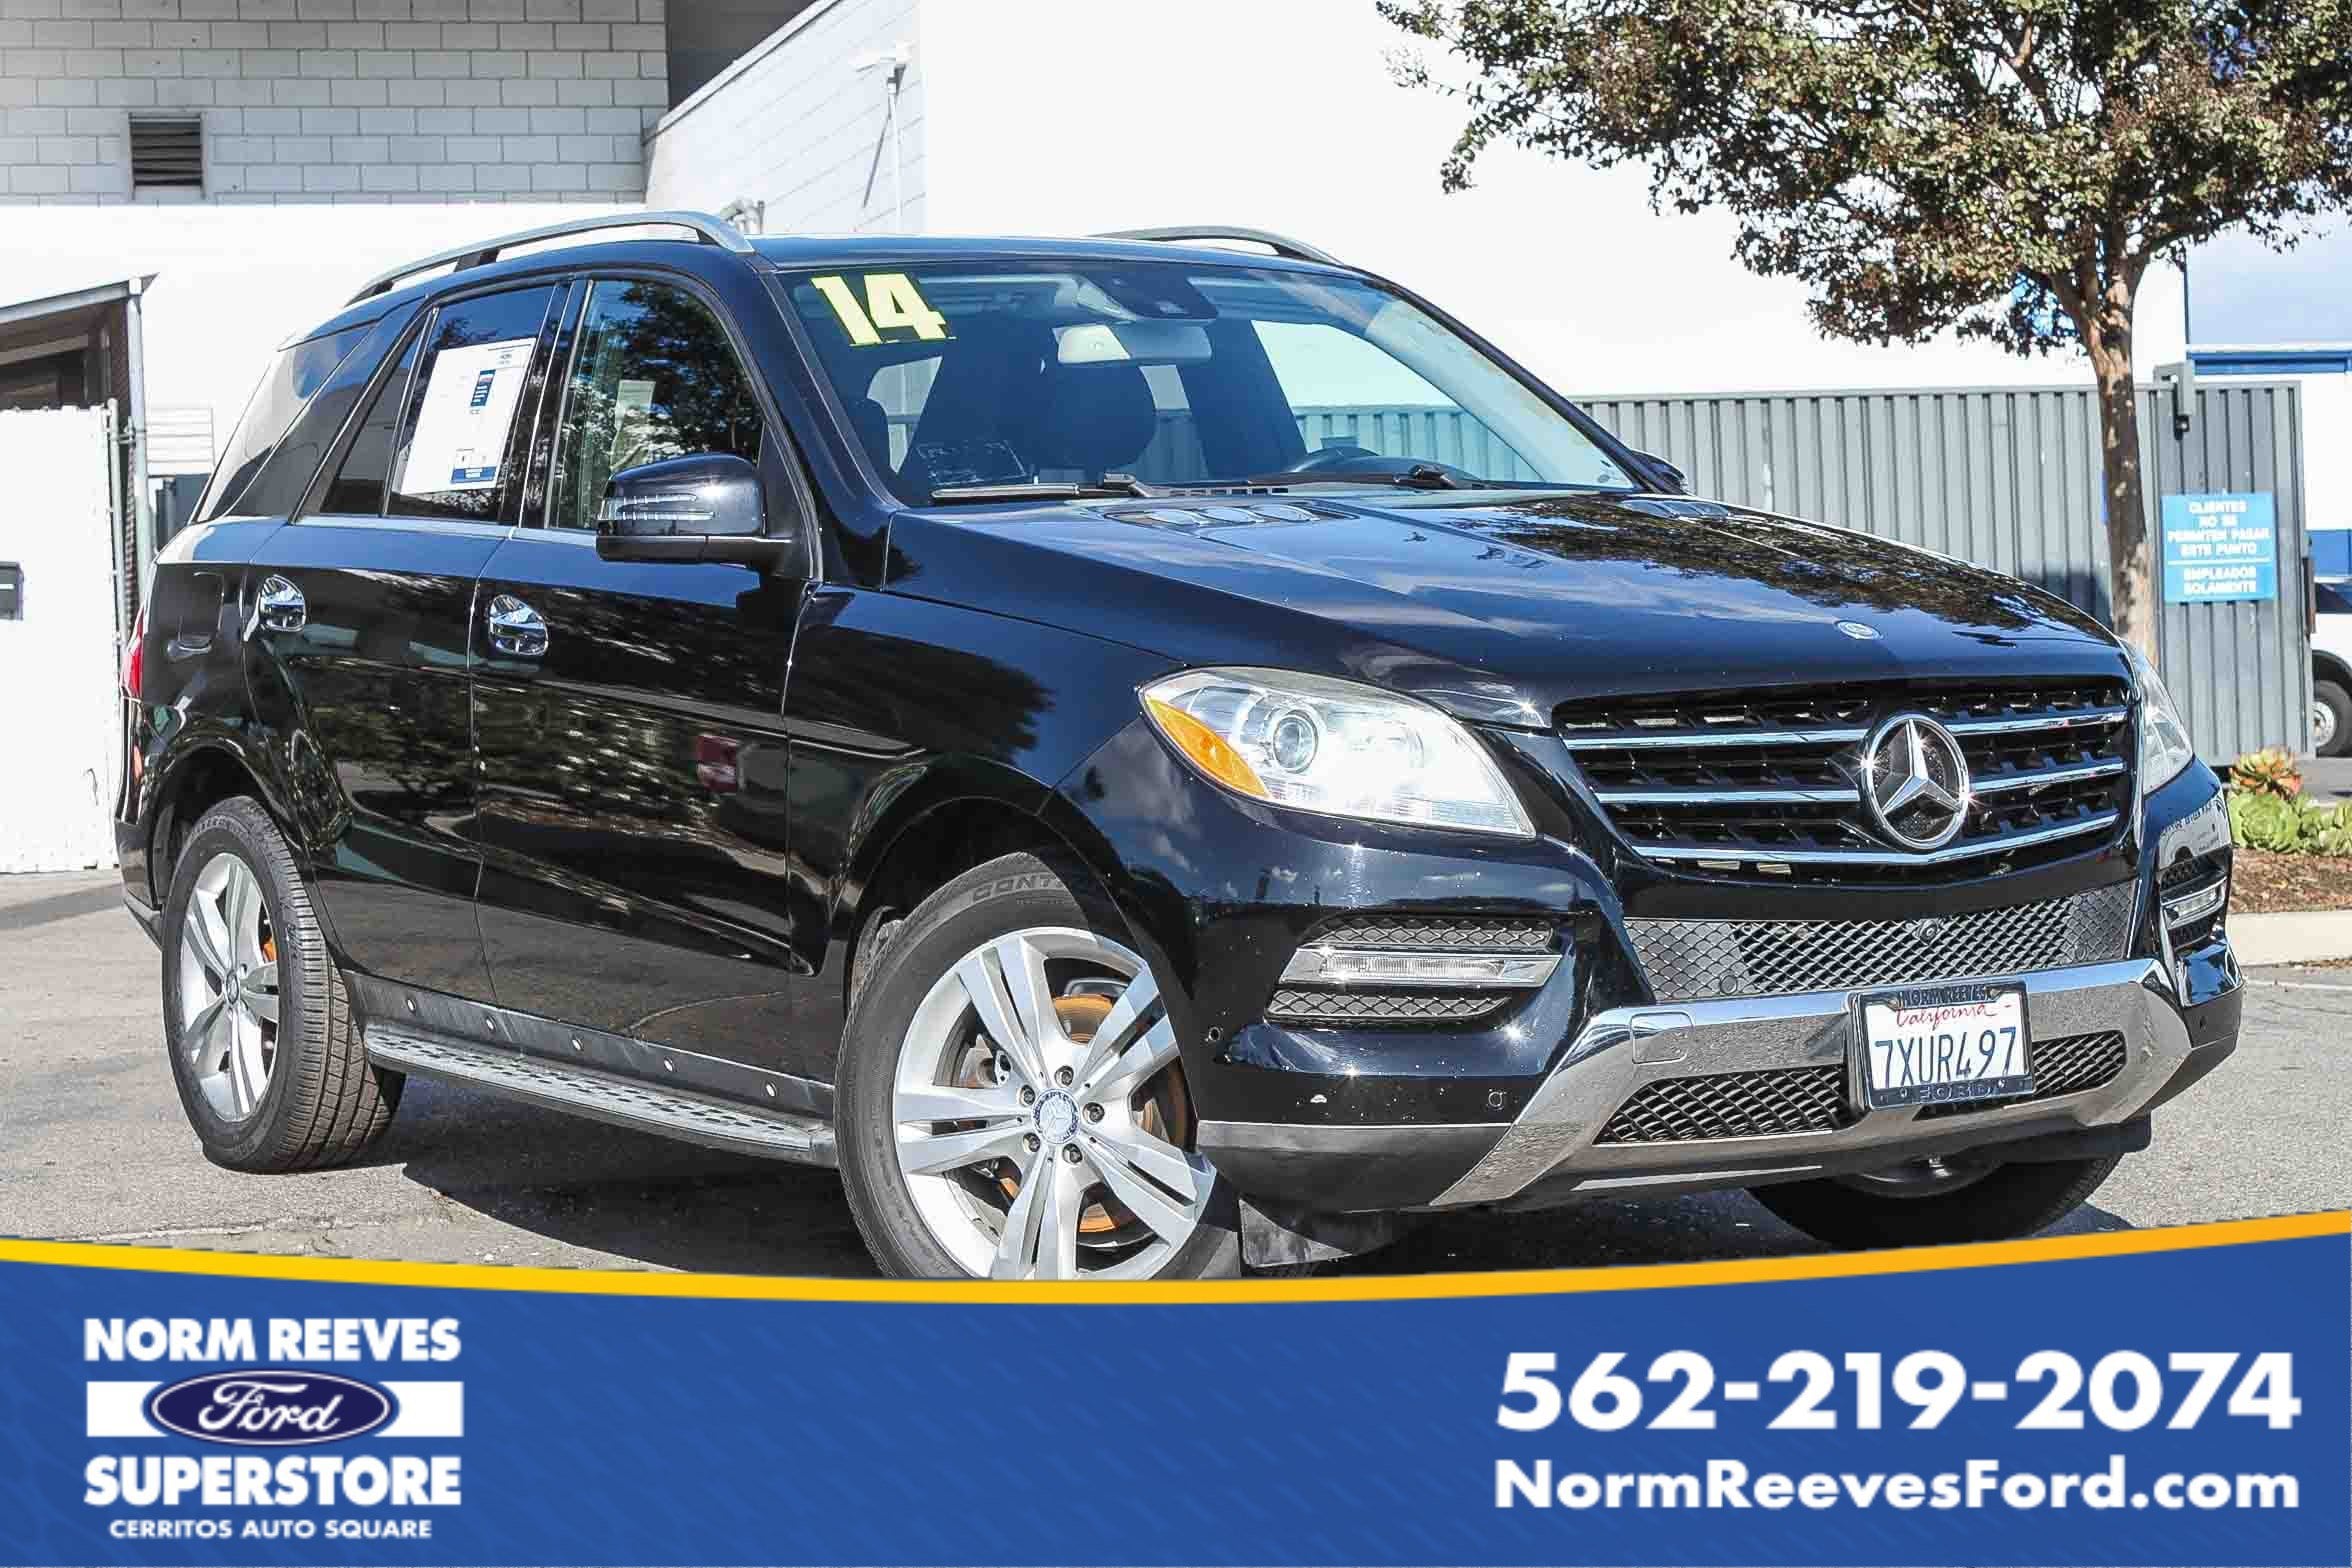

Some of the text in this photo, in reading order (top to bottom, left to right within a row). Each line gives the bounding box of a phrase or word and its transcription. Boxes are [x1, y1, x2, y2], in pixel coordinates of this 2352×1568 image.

[810, 272, 948, 348] 14
[2198, 515, 2217, 528] NO
[2231, 528, 2270, 541] PASAR
[2180, 542, 2257, 557] ESTE PUNTO
[2183, 565, 2257, 581] EMPLEADOS
[2183, 580, 2257, 596] SOLAMENTE
[1902, 984, 1986, 1006] NORM REEVES
[1896, 1003, 1996, 1031] California
[1874, 1026, 2017, 1089] 7XUR497
[1919, 1083, 1994, 1103] FORD
